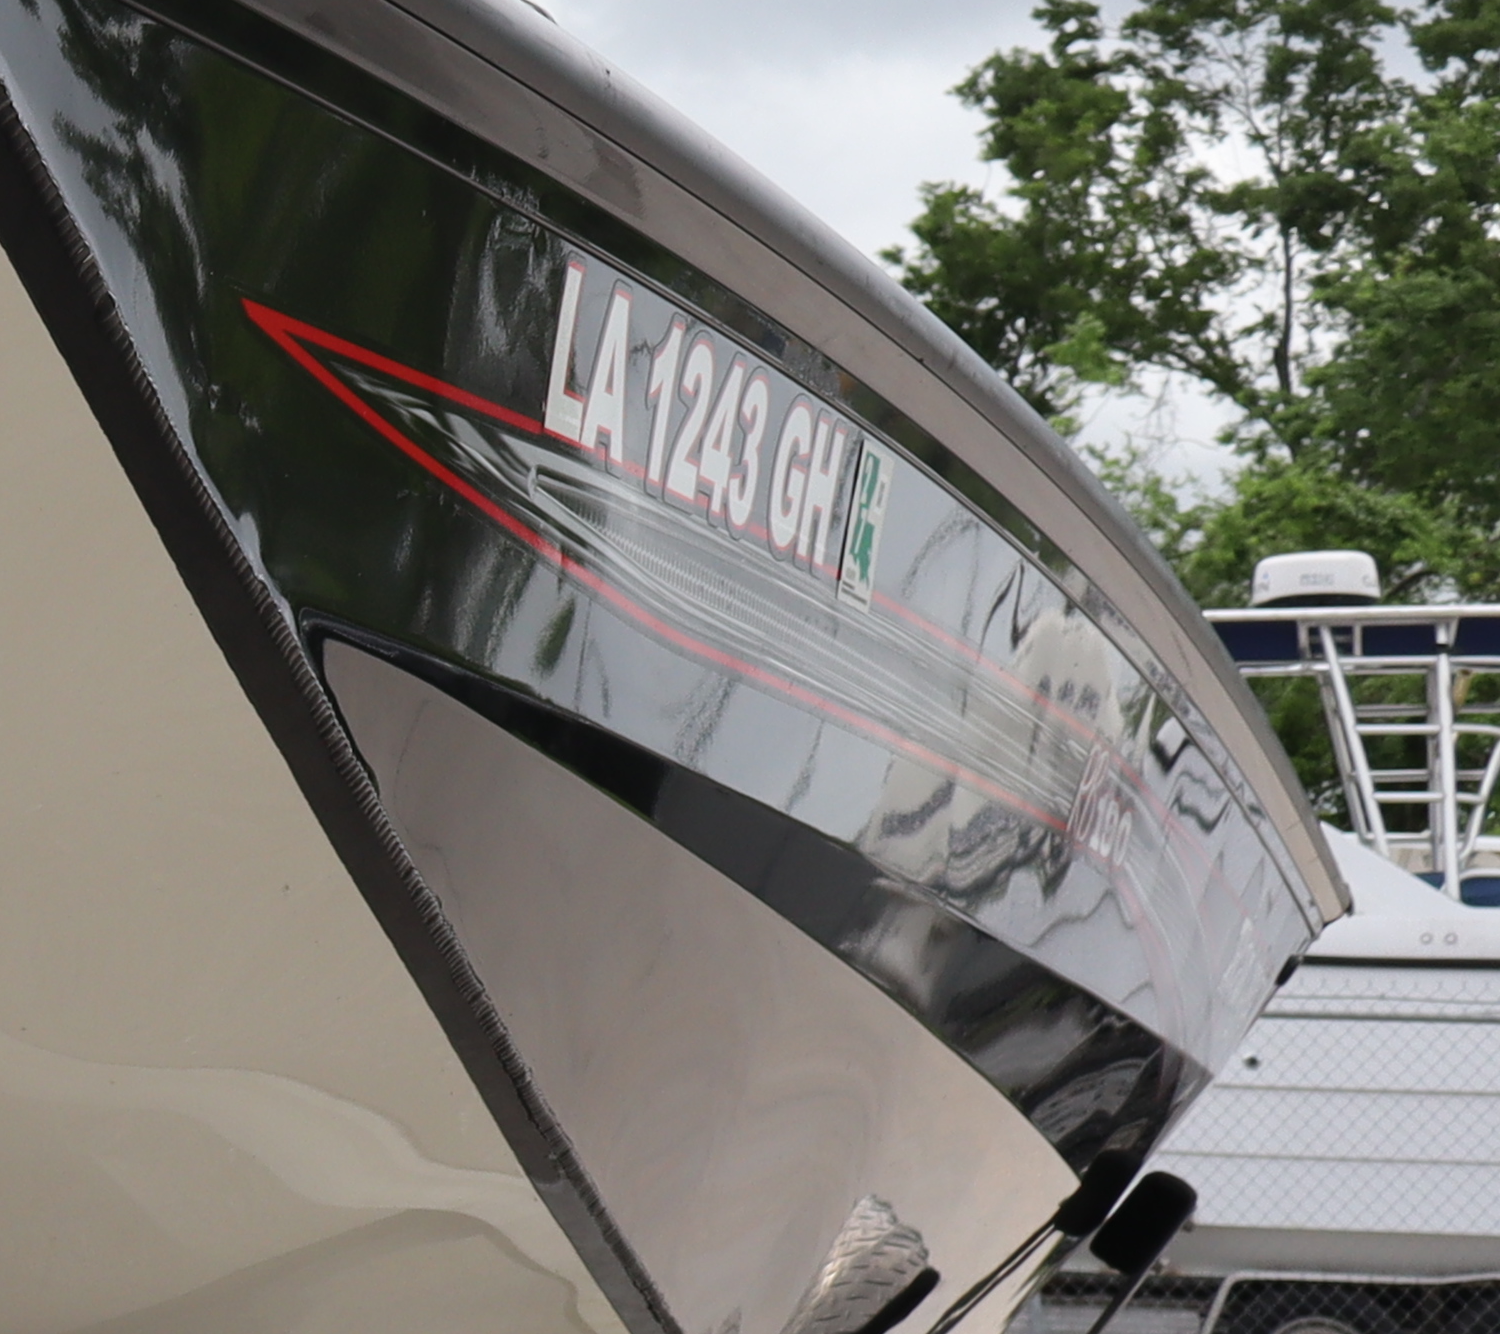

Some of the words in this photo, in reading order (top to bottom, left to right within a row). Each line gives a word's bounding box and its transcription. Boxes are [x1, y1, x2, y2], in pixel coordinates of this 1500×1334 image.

[543, 259, 632, 465] LA
[647, 320, 770, 528] 1243
[769, 399, 849, 567] GH
